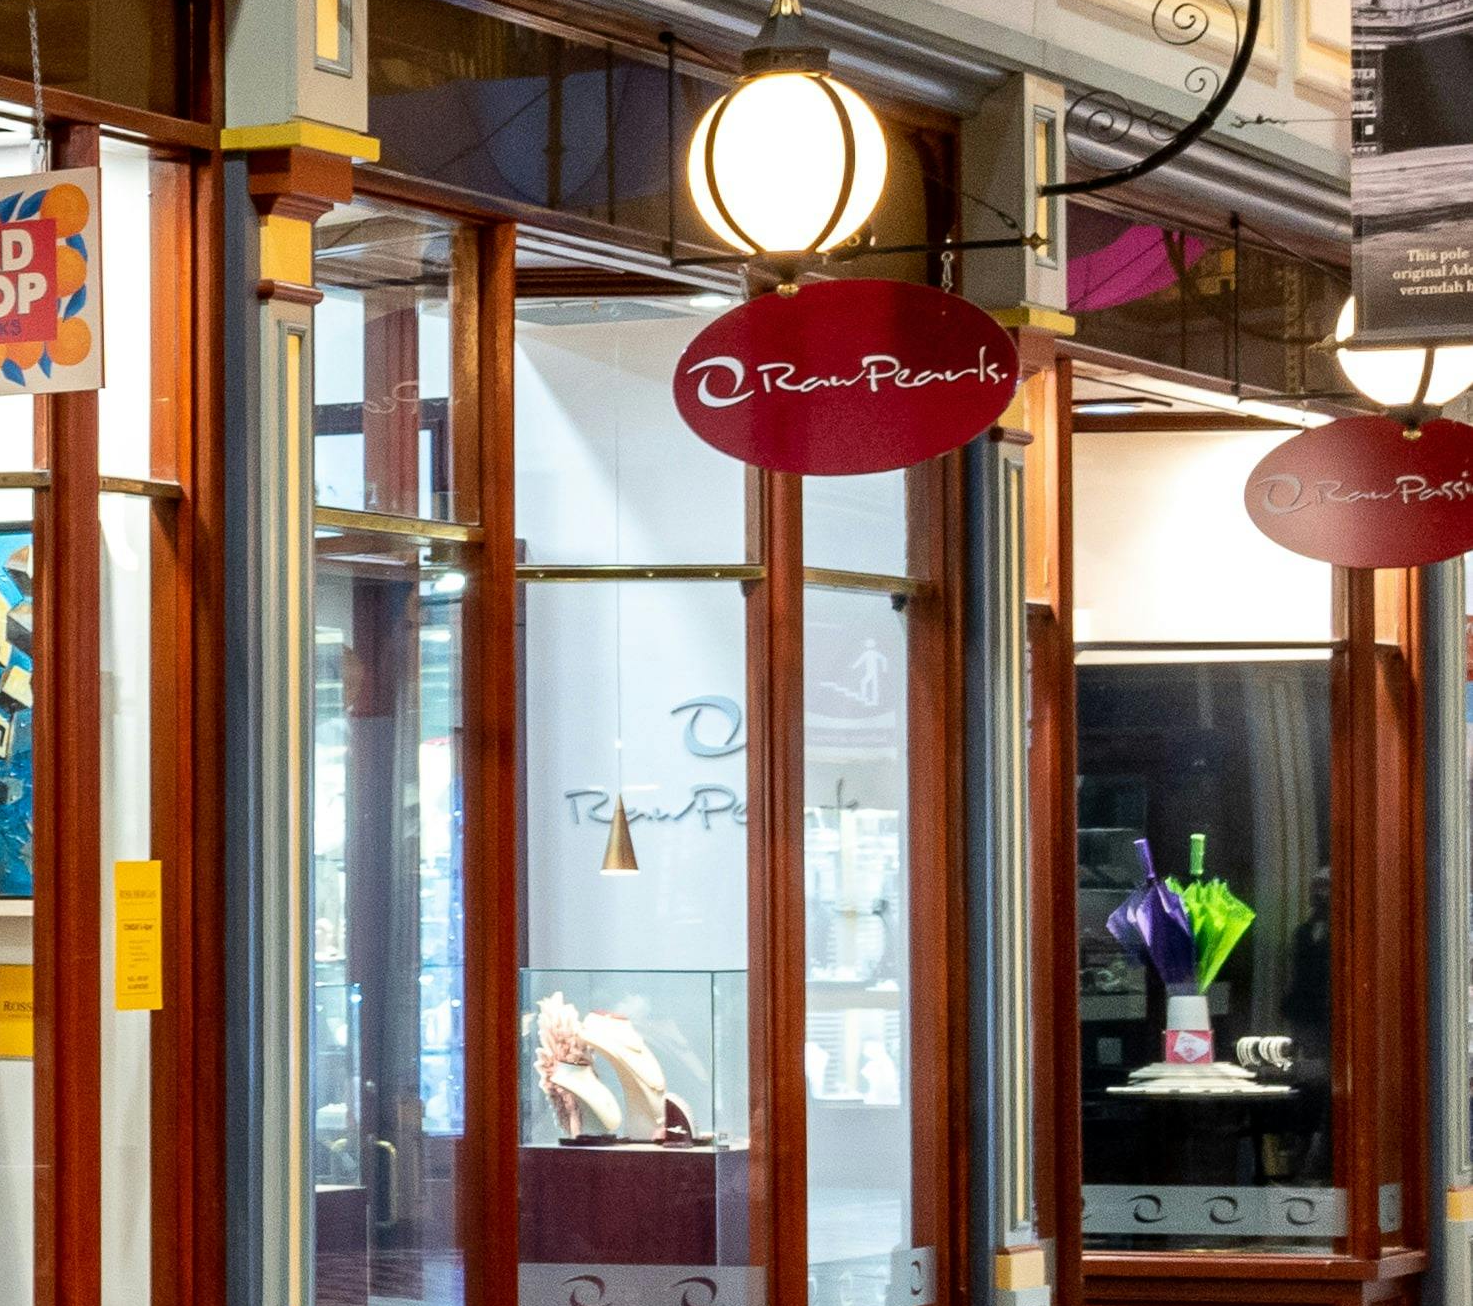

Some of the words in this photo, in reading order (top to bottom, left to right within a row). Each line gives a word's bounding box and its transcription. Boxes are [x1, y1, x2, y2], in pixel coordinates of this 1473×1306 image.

[1406, 248, 1437, 264] This
[1440, 246, 1471, 266] pole
[1392, 264, 1447, 283] original
[1400, 280, 1464, 297] verandah
[3, 1000, 32, 1012] ROSS
